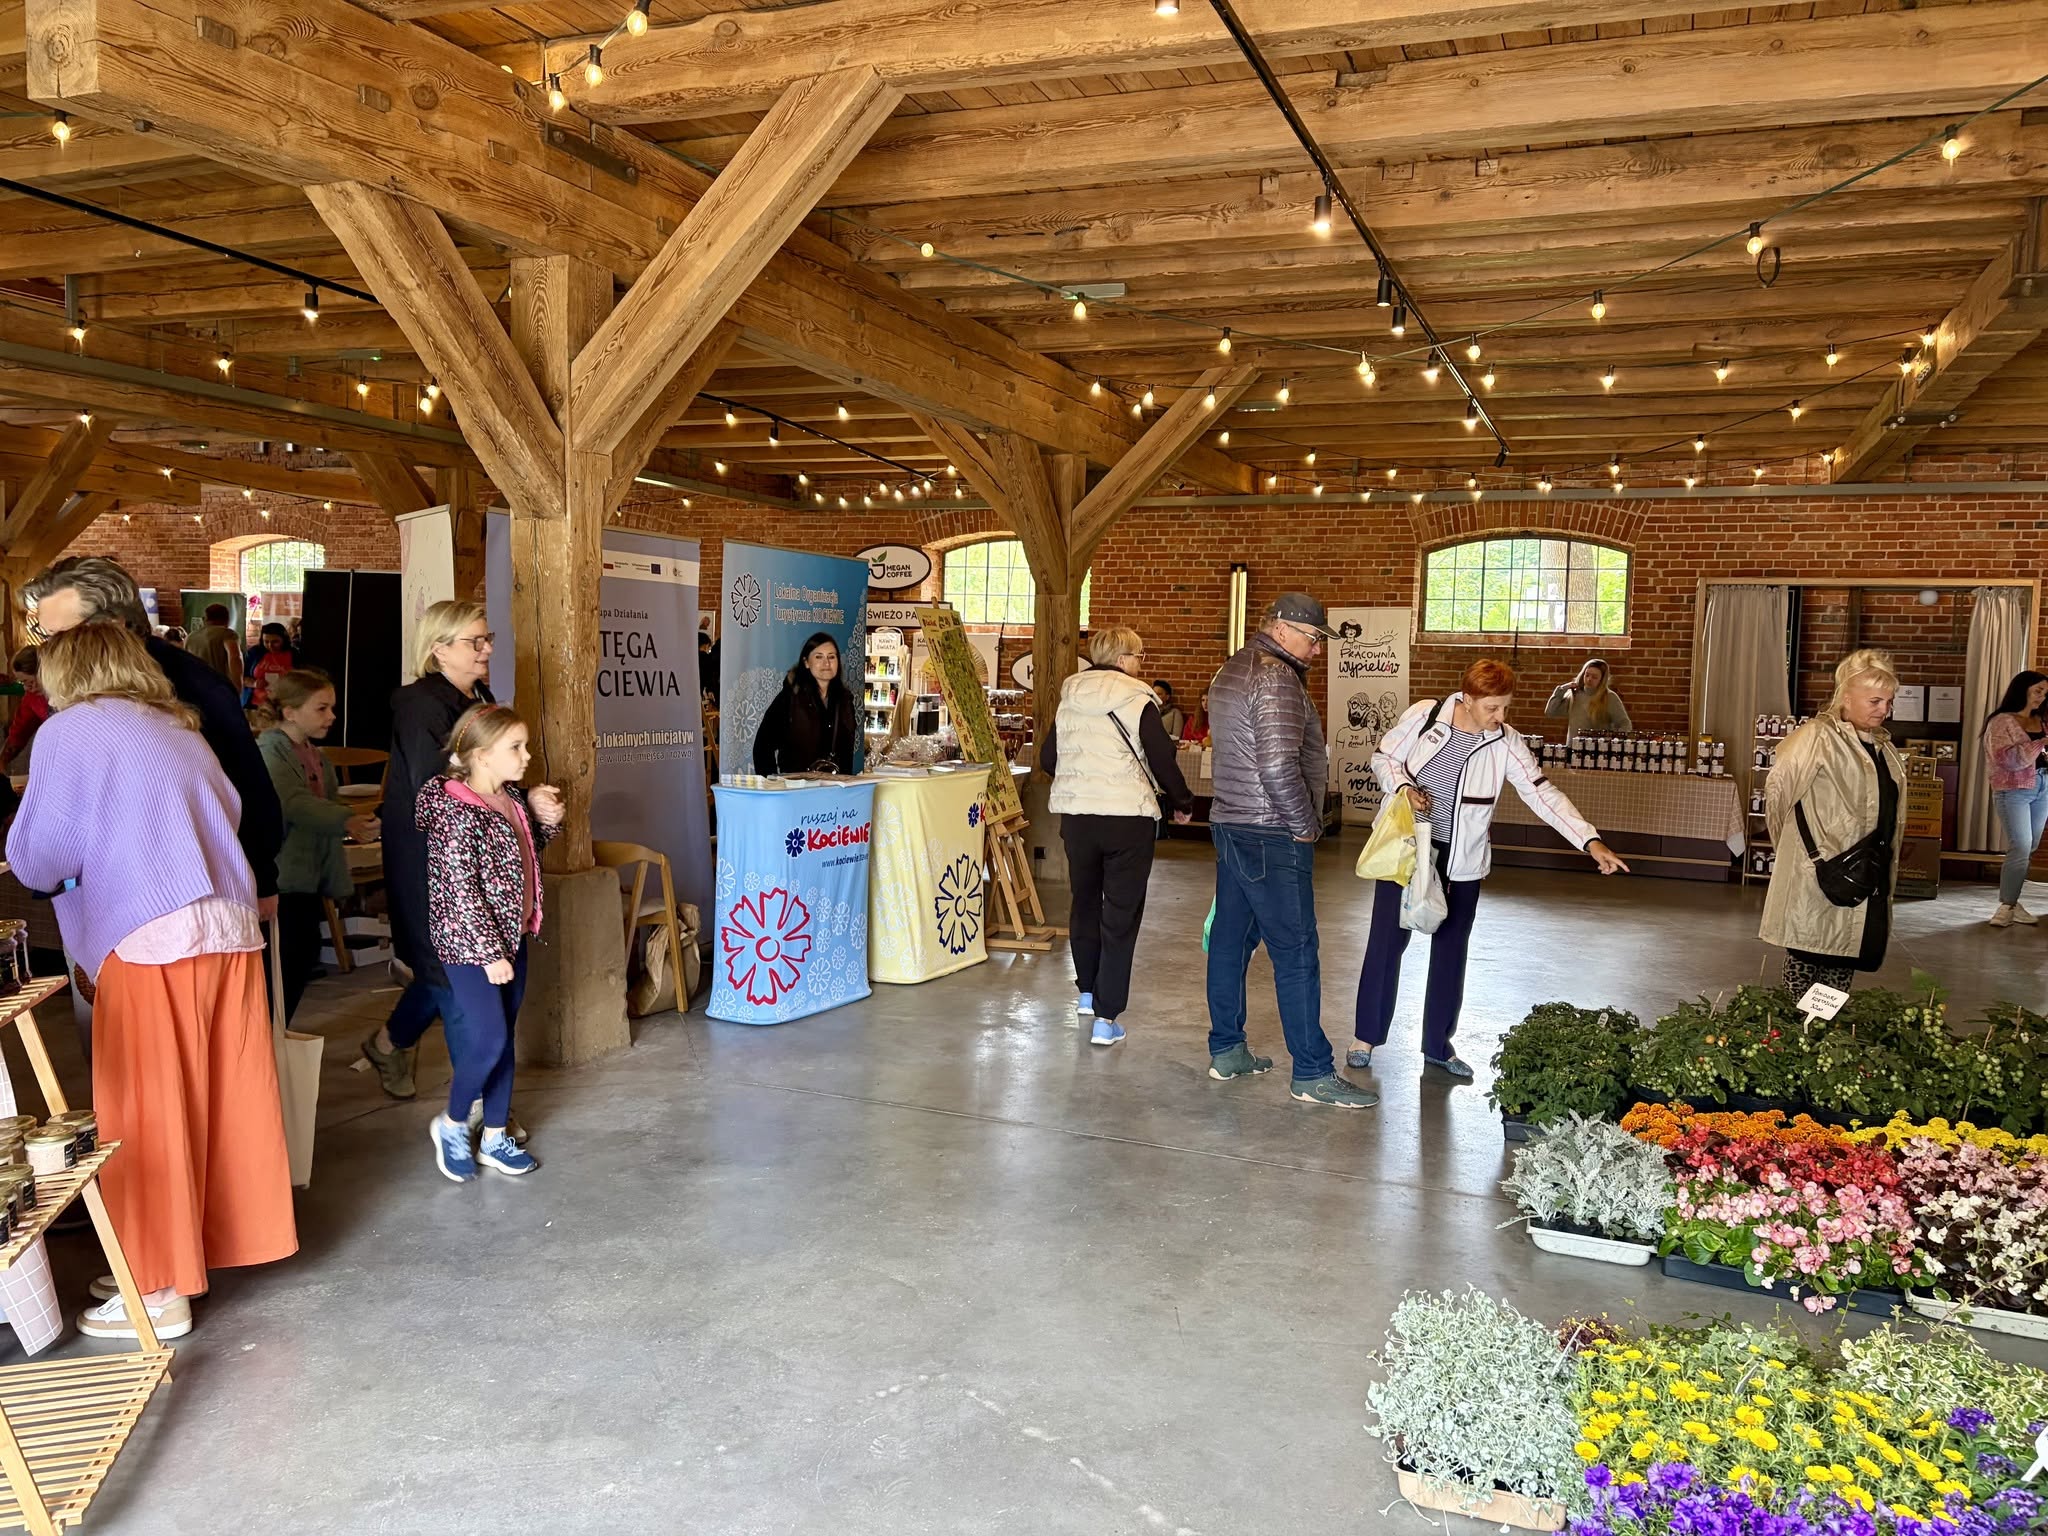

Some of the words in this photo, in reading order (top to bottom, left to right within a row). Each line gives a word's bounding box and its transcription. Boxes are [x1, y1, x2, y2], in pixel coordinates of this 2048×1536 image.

[774, 582, 800, 600] Lokalna
[801, 585, 838, 607] Organizacja
[614, 608, 648, 619] Działania
[774, 604, 811, 625] Turystyczna
[867, 609, 903, 620] ŚWIEŻO
[905, 610, 918, 620] PA
[600, 630, 658, 665] TĘGA
[597, 670, 681, 697] CIEWIA
[603, 731, 650, 748] lokalnych
[652, 729, 694, 746] inicjatyw
[801, 806, 838, 825] ruszaj
[842, 808, 858, 819] na
